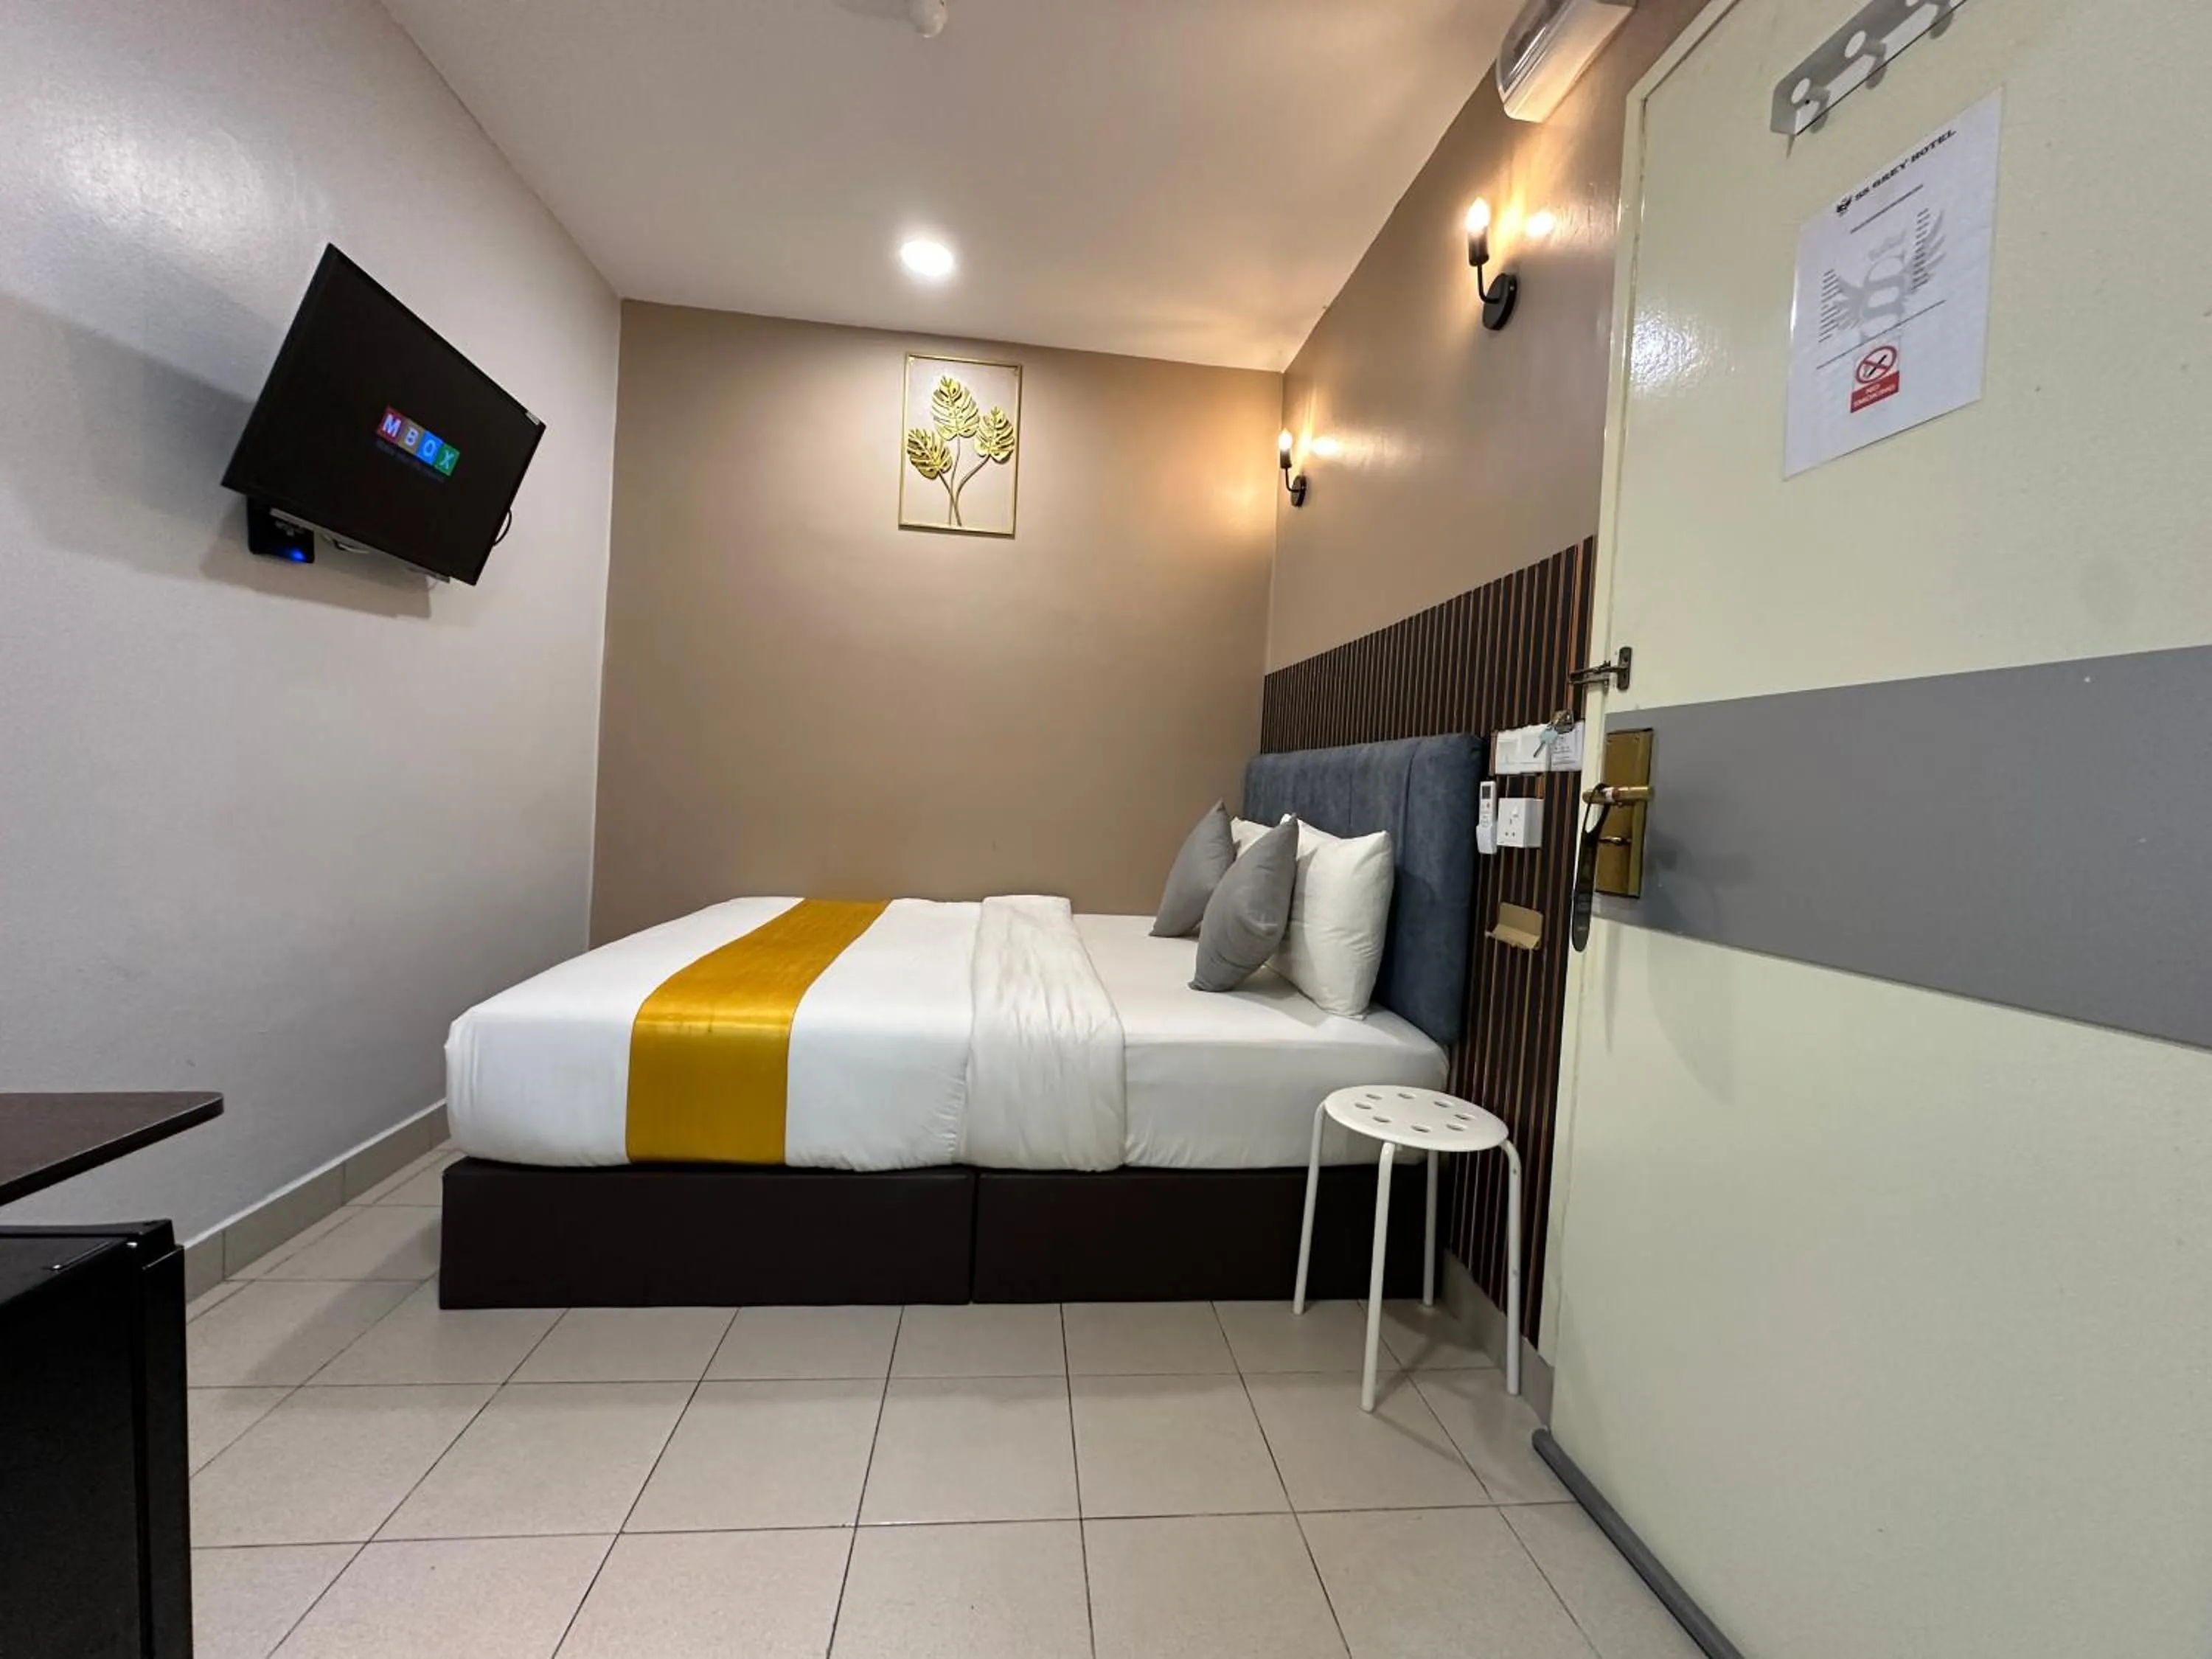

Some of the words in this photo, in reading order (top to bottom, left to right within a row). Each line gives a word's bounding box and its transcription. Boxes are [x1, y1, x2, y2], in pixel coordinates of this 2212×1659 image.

[1872, 158, 1910, 188] GREY
[1911, 130, 1957, 162] HOTEL
[382, 413, 455, 470] MBOX
